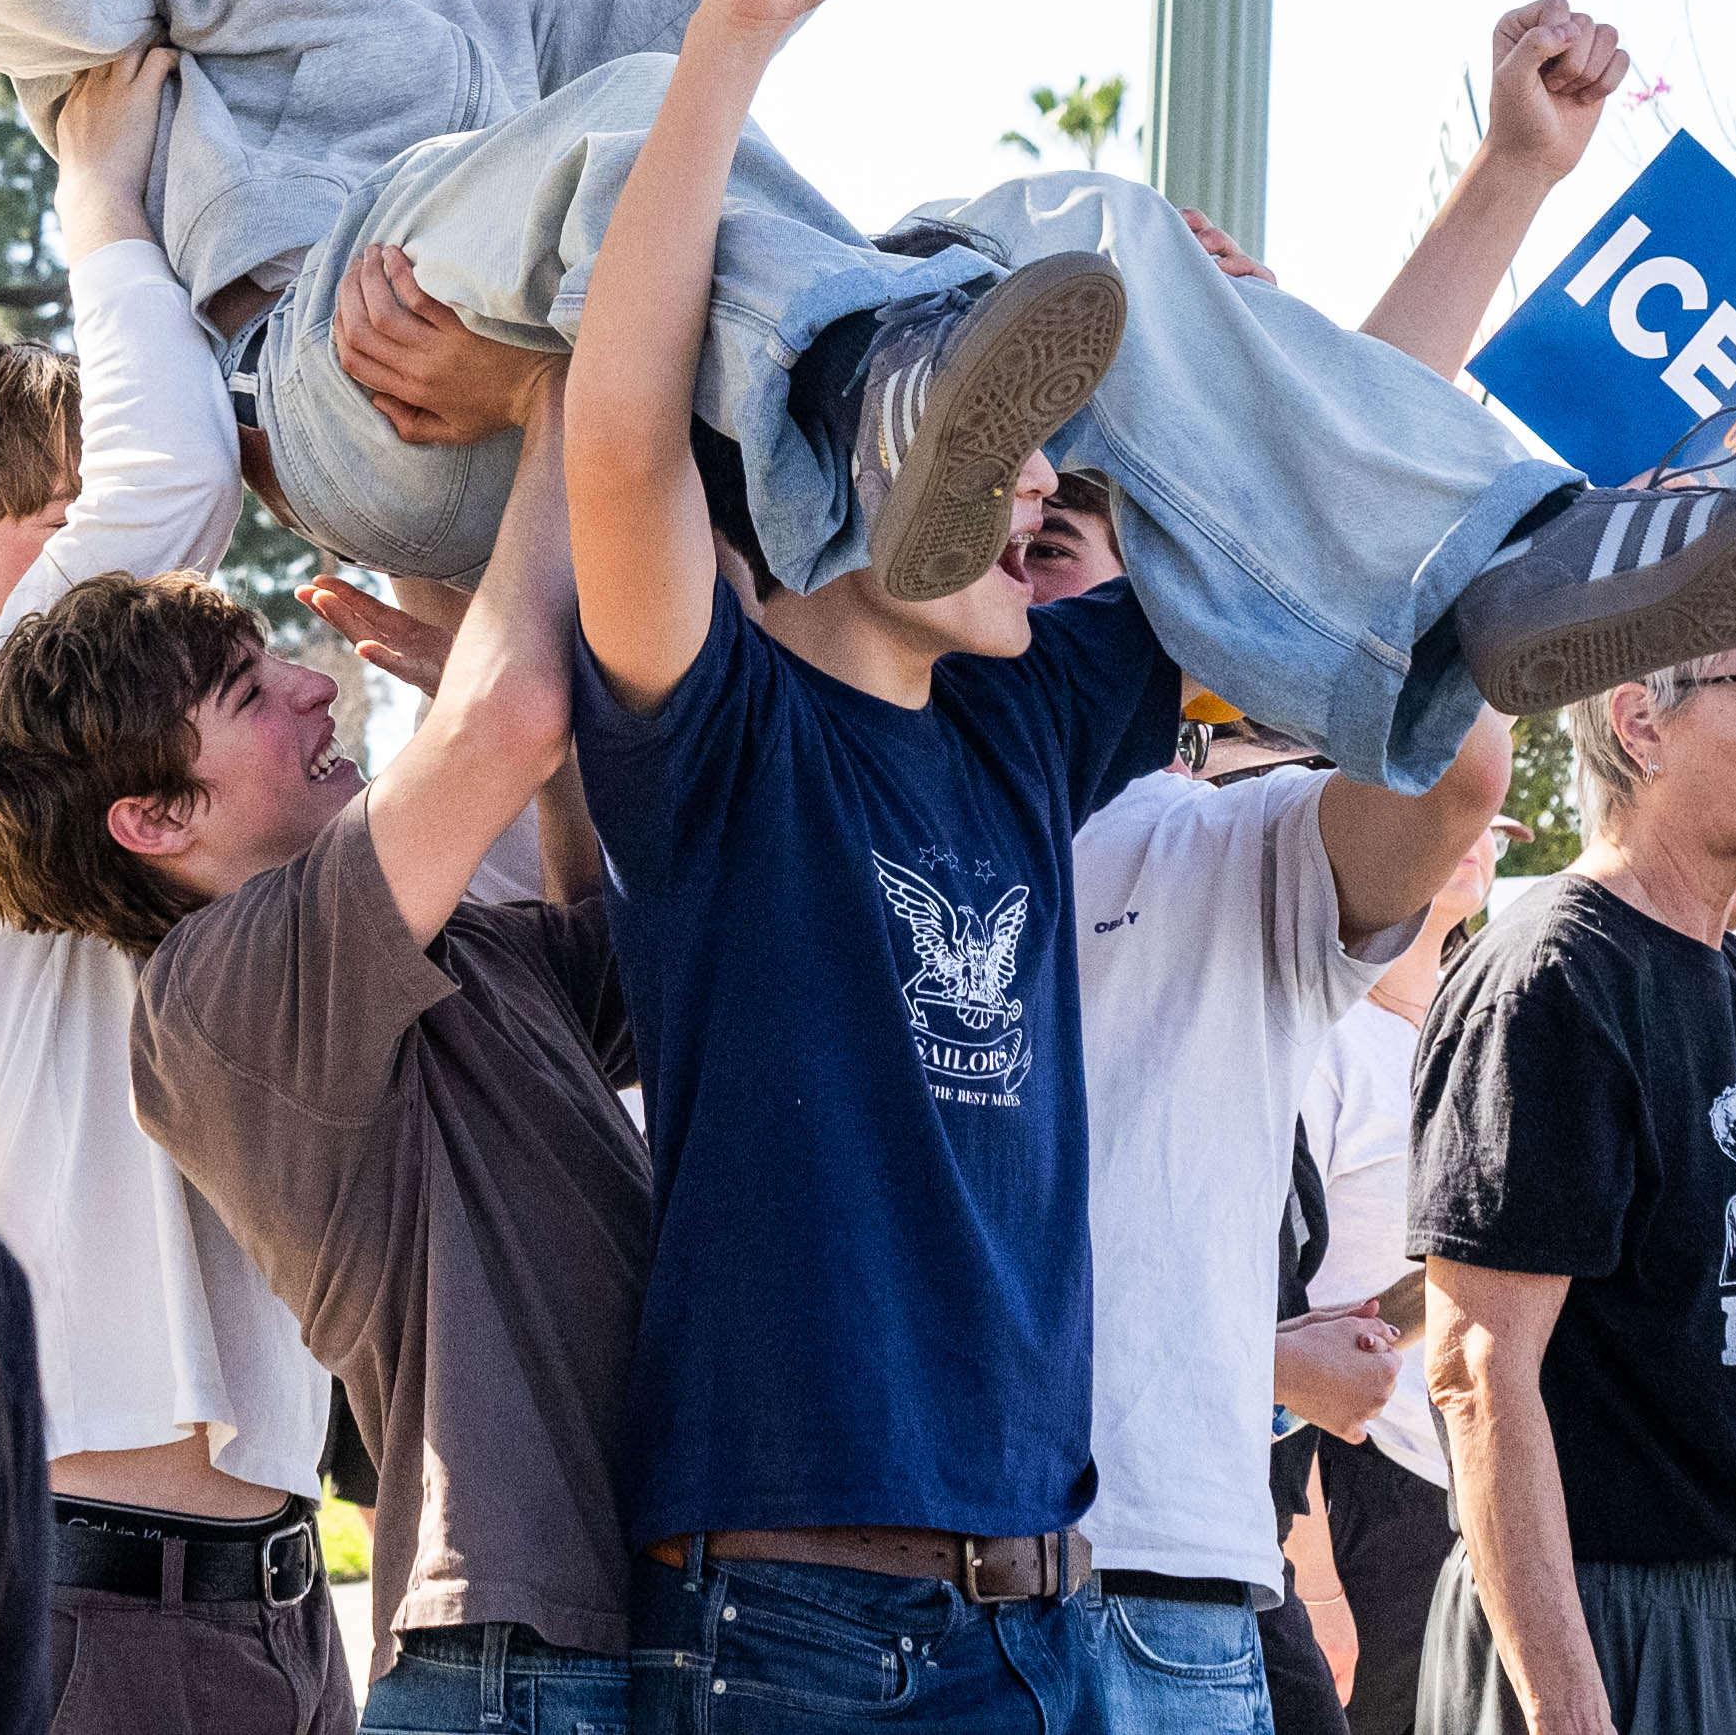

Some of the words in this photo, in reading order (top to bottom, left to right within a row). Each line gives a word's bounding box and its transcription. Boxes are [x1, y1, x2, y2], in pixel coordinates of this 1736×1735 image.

[914, 1036, 1007, 1072] SAILORS
[929, 1084, 954, 1100] THE
[957, 1089, 990, 1105] BEST
